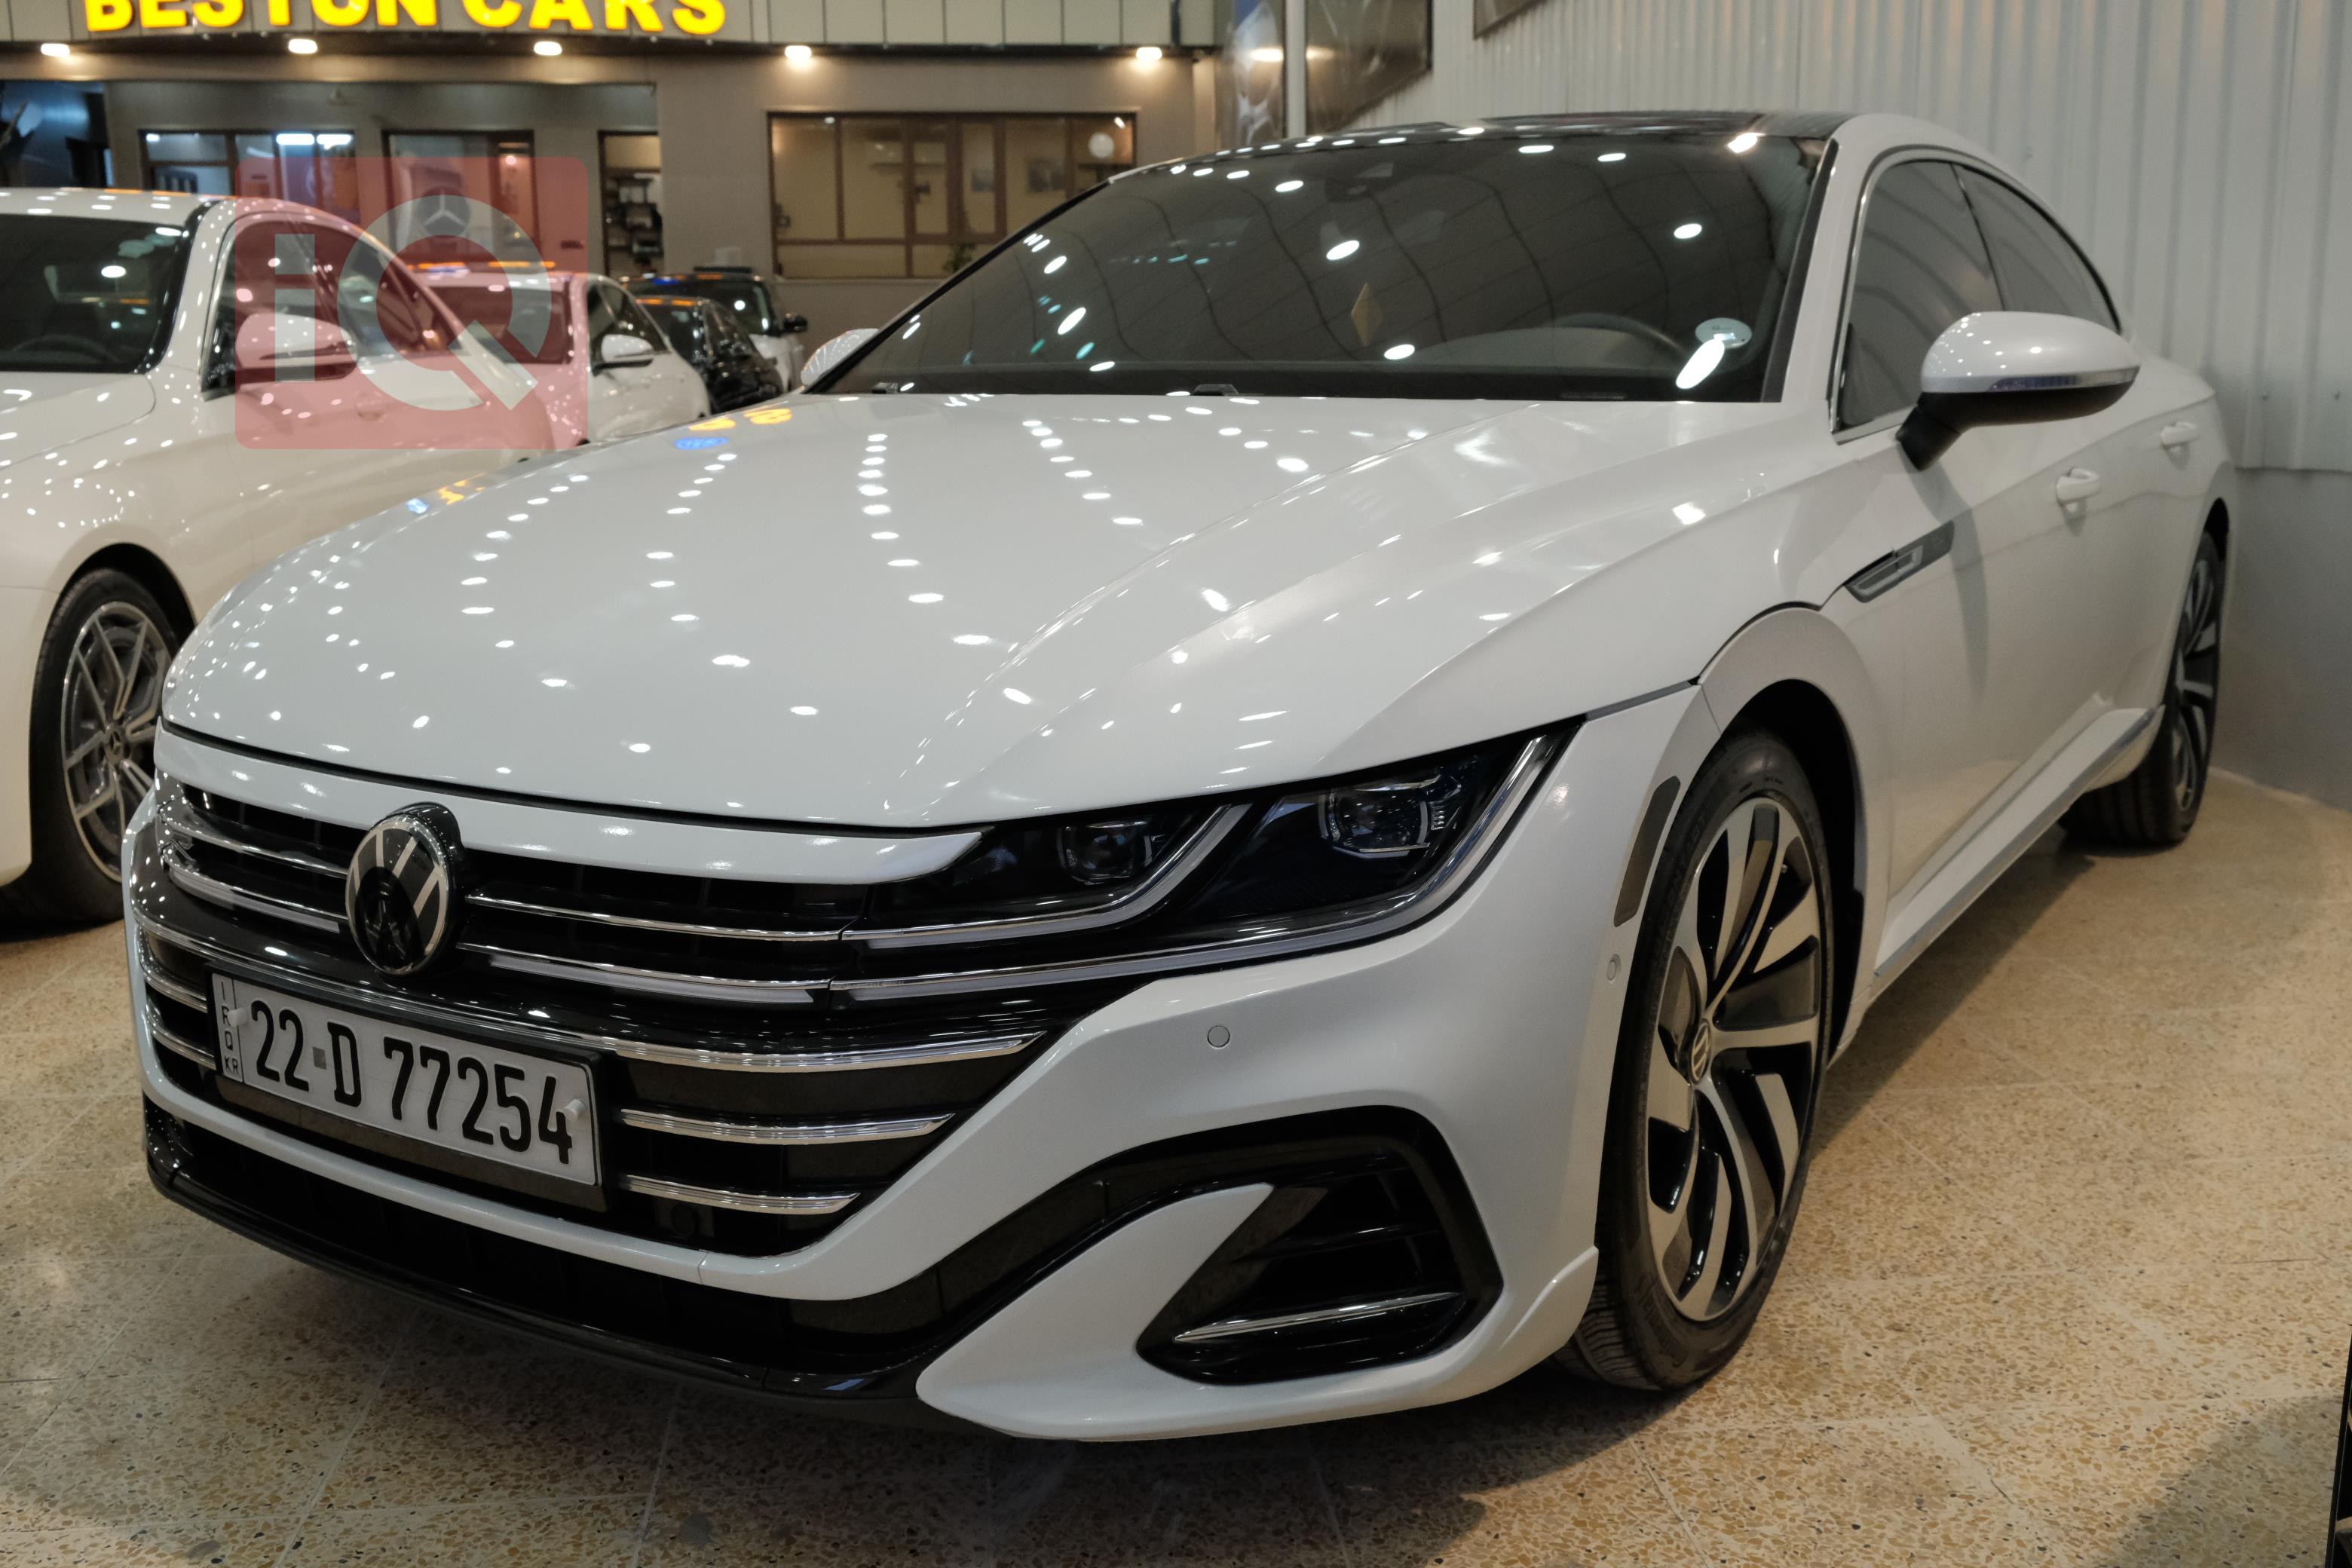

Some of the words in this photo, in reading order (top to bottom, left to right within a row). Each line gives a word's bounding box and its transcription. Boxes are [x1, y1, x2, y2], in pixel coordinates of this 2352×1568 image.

[461, 0, 727, 35] CARS
[250, 1000, 310, 1092] 22
[326, 1021, 362, 1108] D
[383, 1036, 573, 1165] 77254
